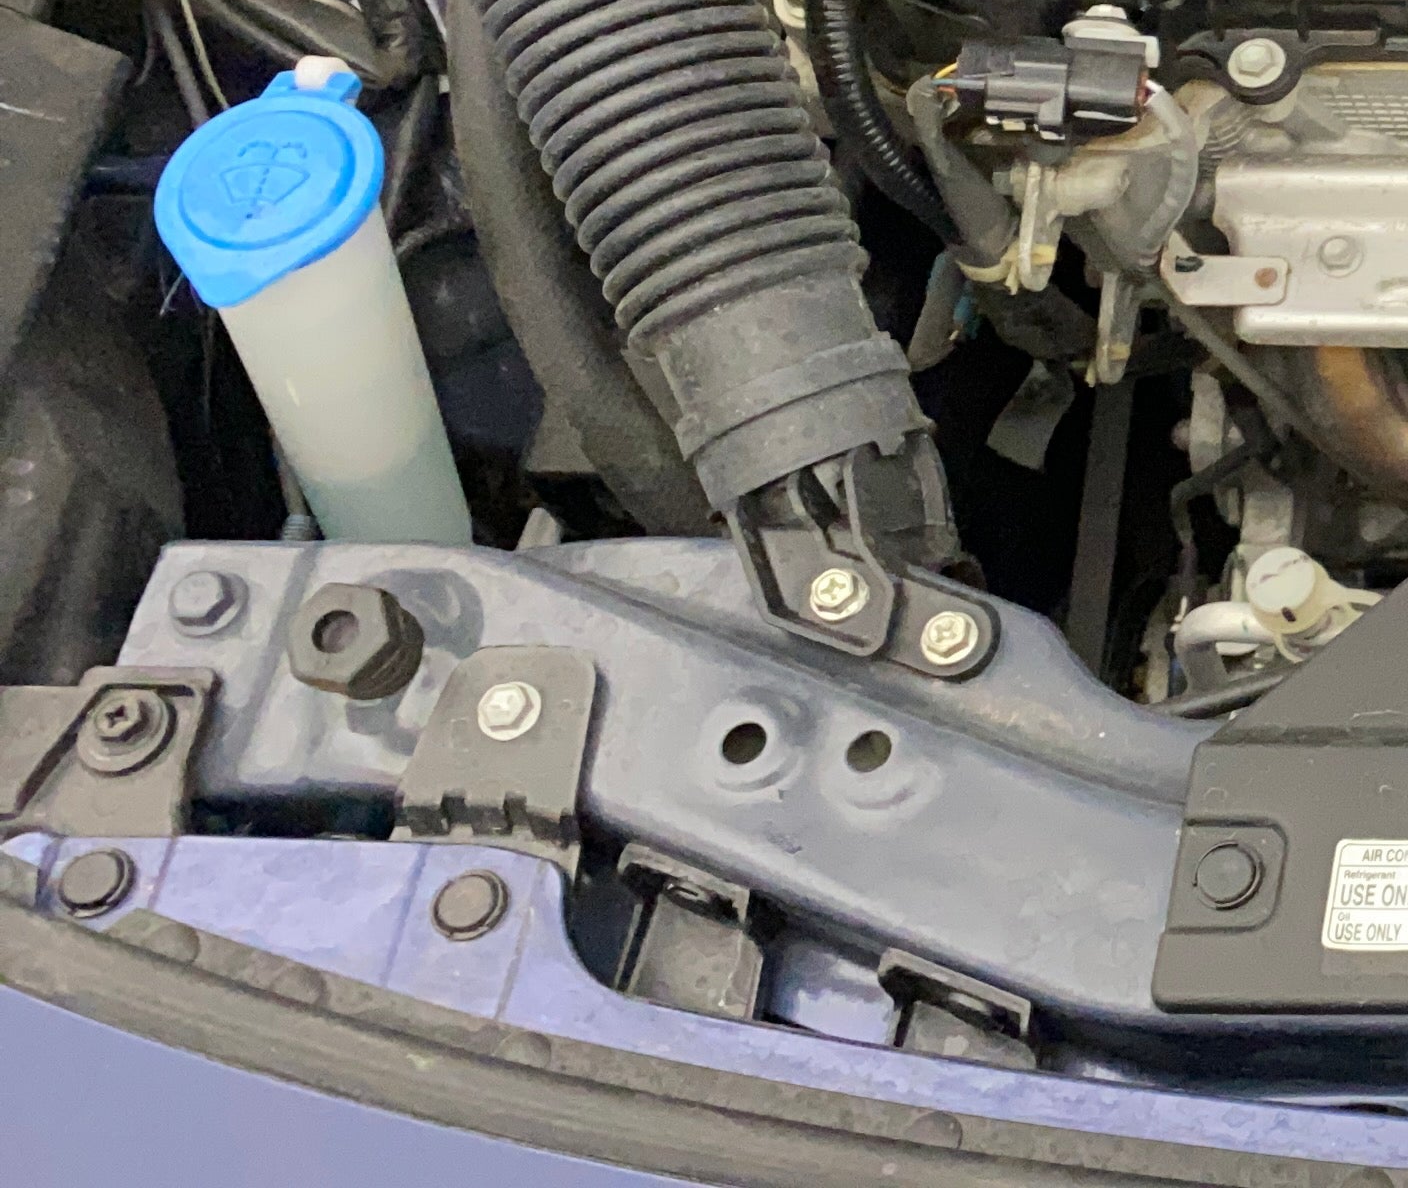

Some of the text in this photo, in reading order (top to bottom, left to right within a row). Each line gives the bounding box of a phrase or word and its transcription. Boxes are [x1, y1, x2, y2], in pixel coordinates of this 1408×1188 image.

[1361, 848, 1383, 862] AIR
[1343, 870, 1396, 881] Refrigerant
[1340, 884, 1377, 906] USE
[1334, 923, 1362, 941] USE
[1365, 923, 1402, 941] ONLY
